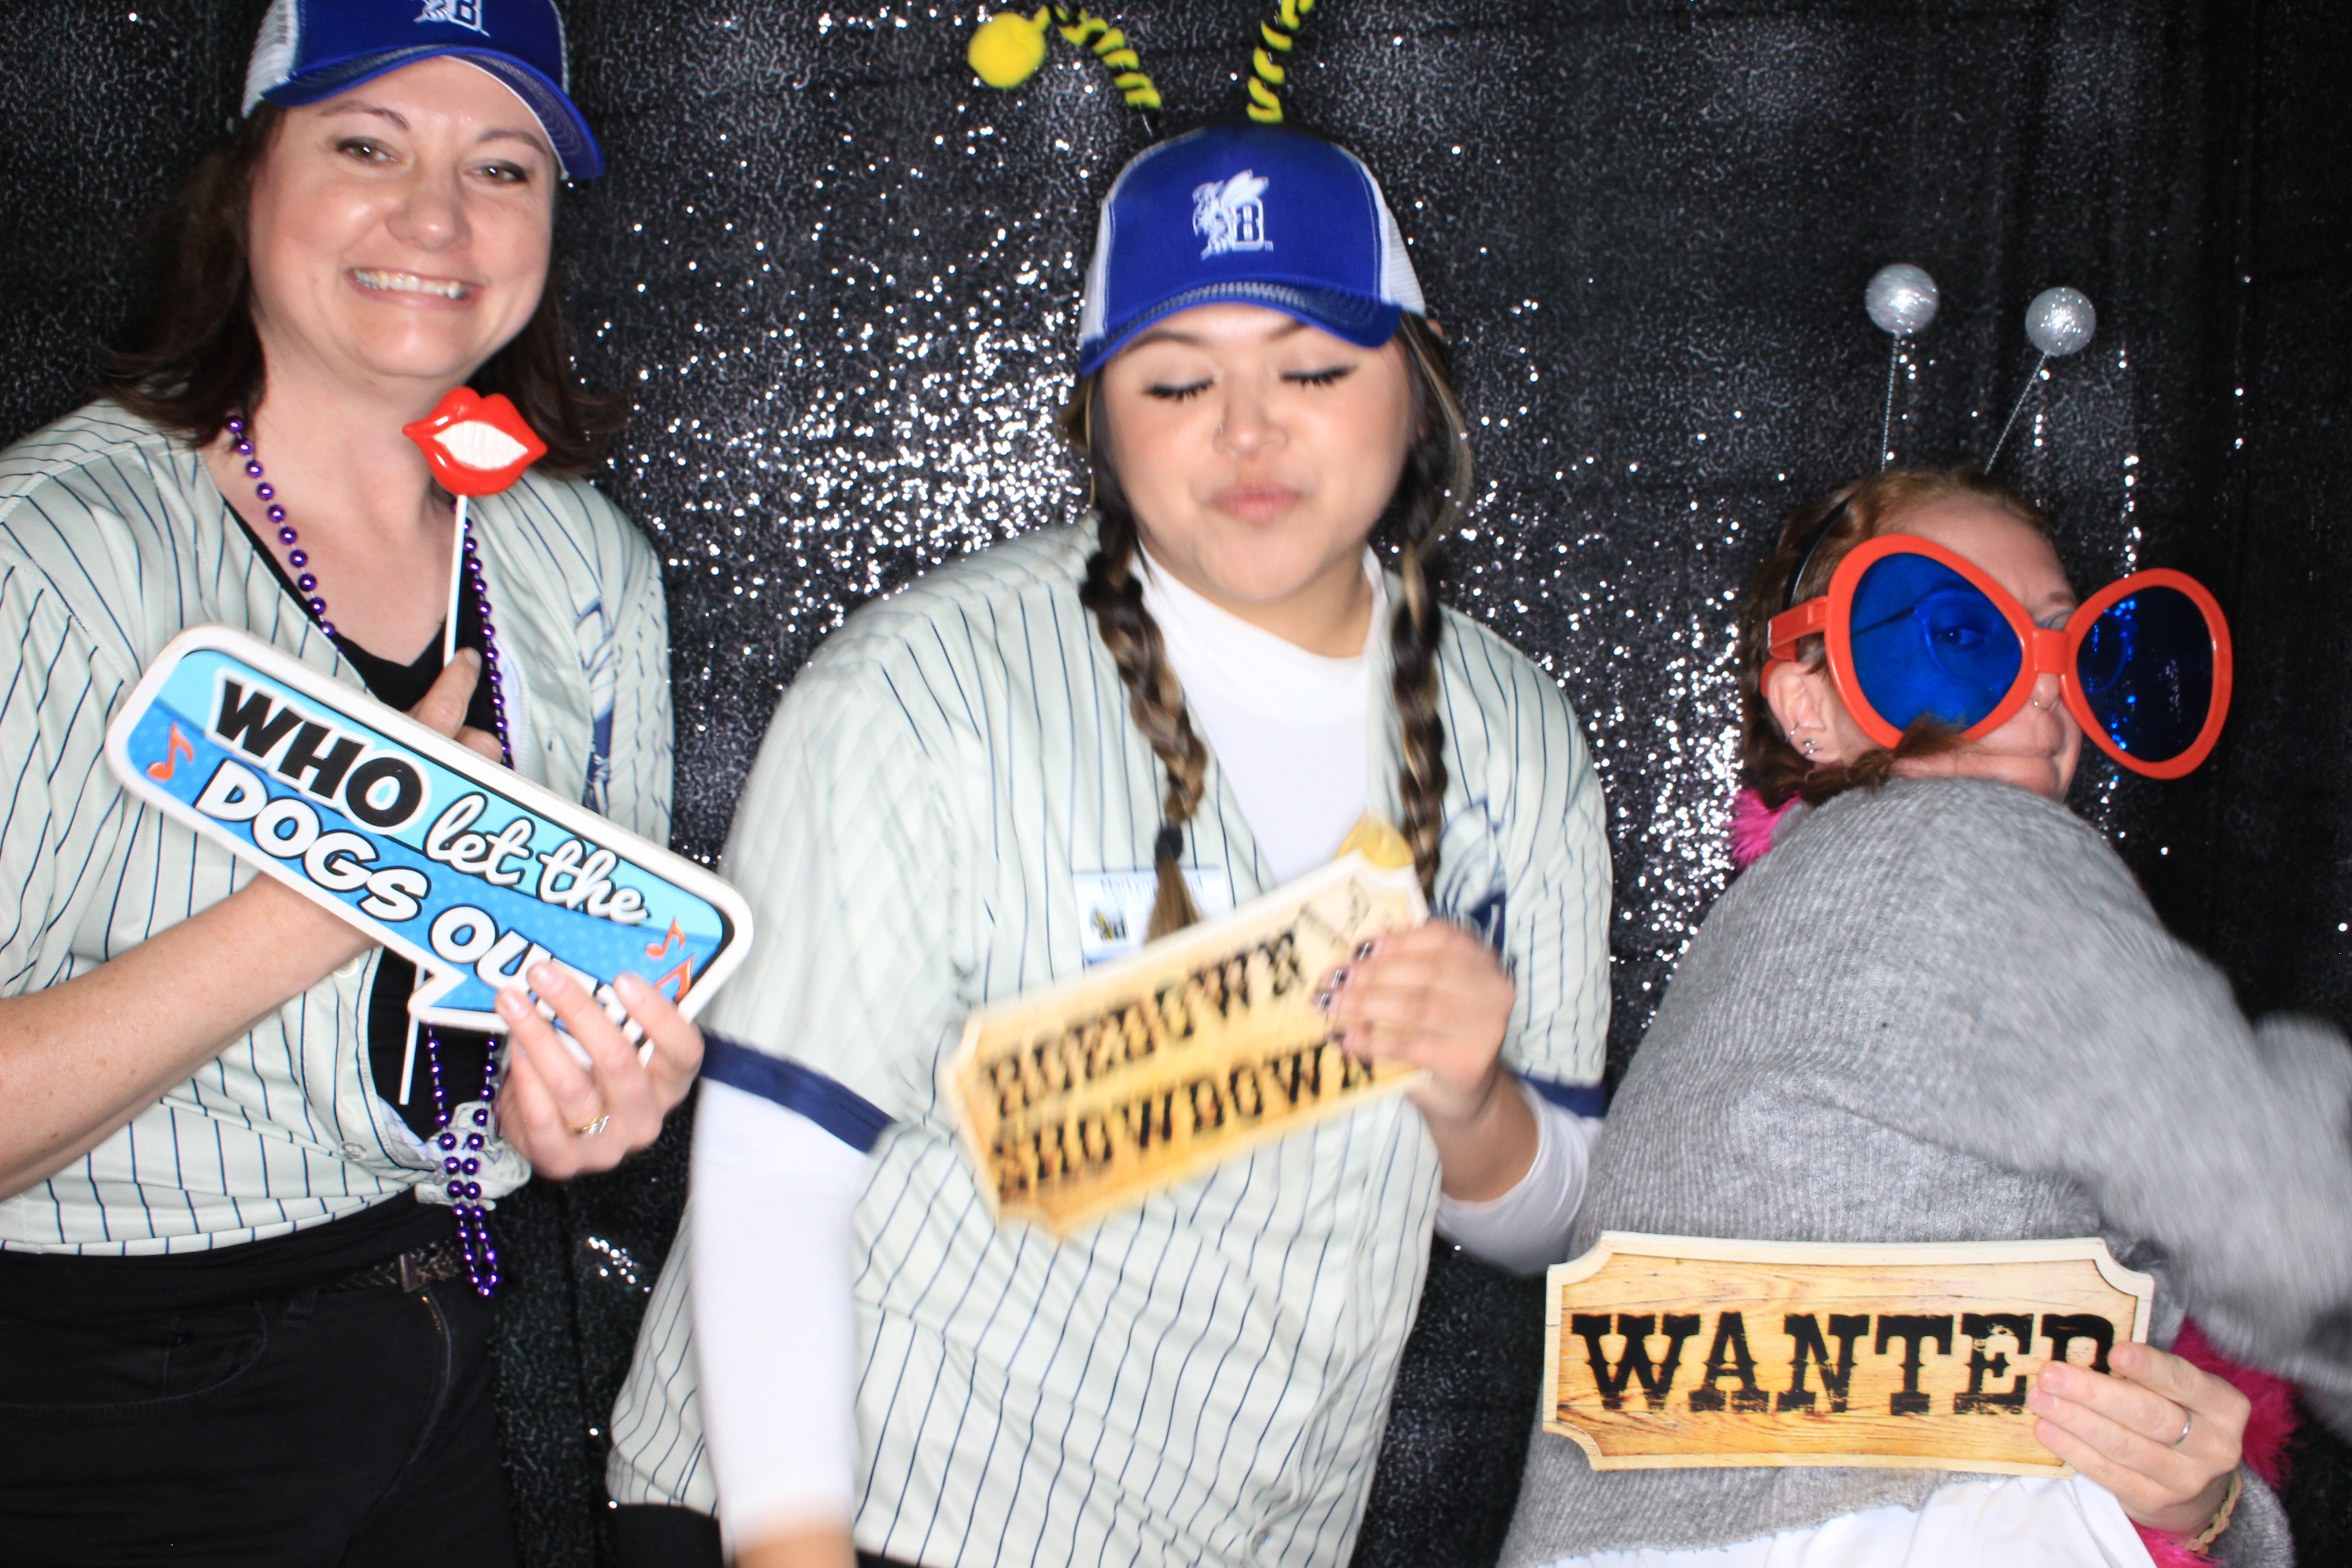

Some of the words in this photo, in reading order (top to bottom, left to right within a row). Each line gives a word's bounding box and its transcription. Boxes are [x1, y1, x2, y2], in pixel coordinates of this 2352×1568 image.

[194, 759, 430, 922] DOGS
[215, 680, 423, 828] WHO
[425, 791, 534, 885] let
[537, 836, 651, 925] the
